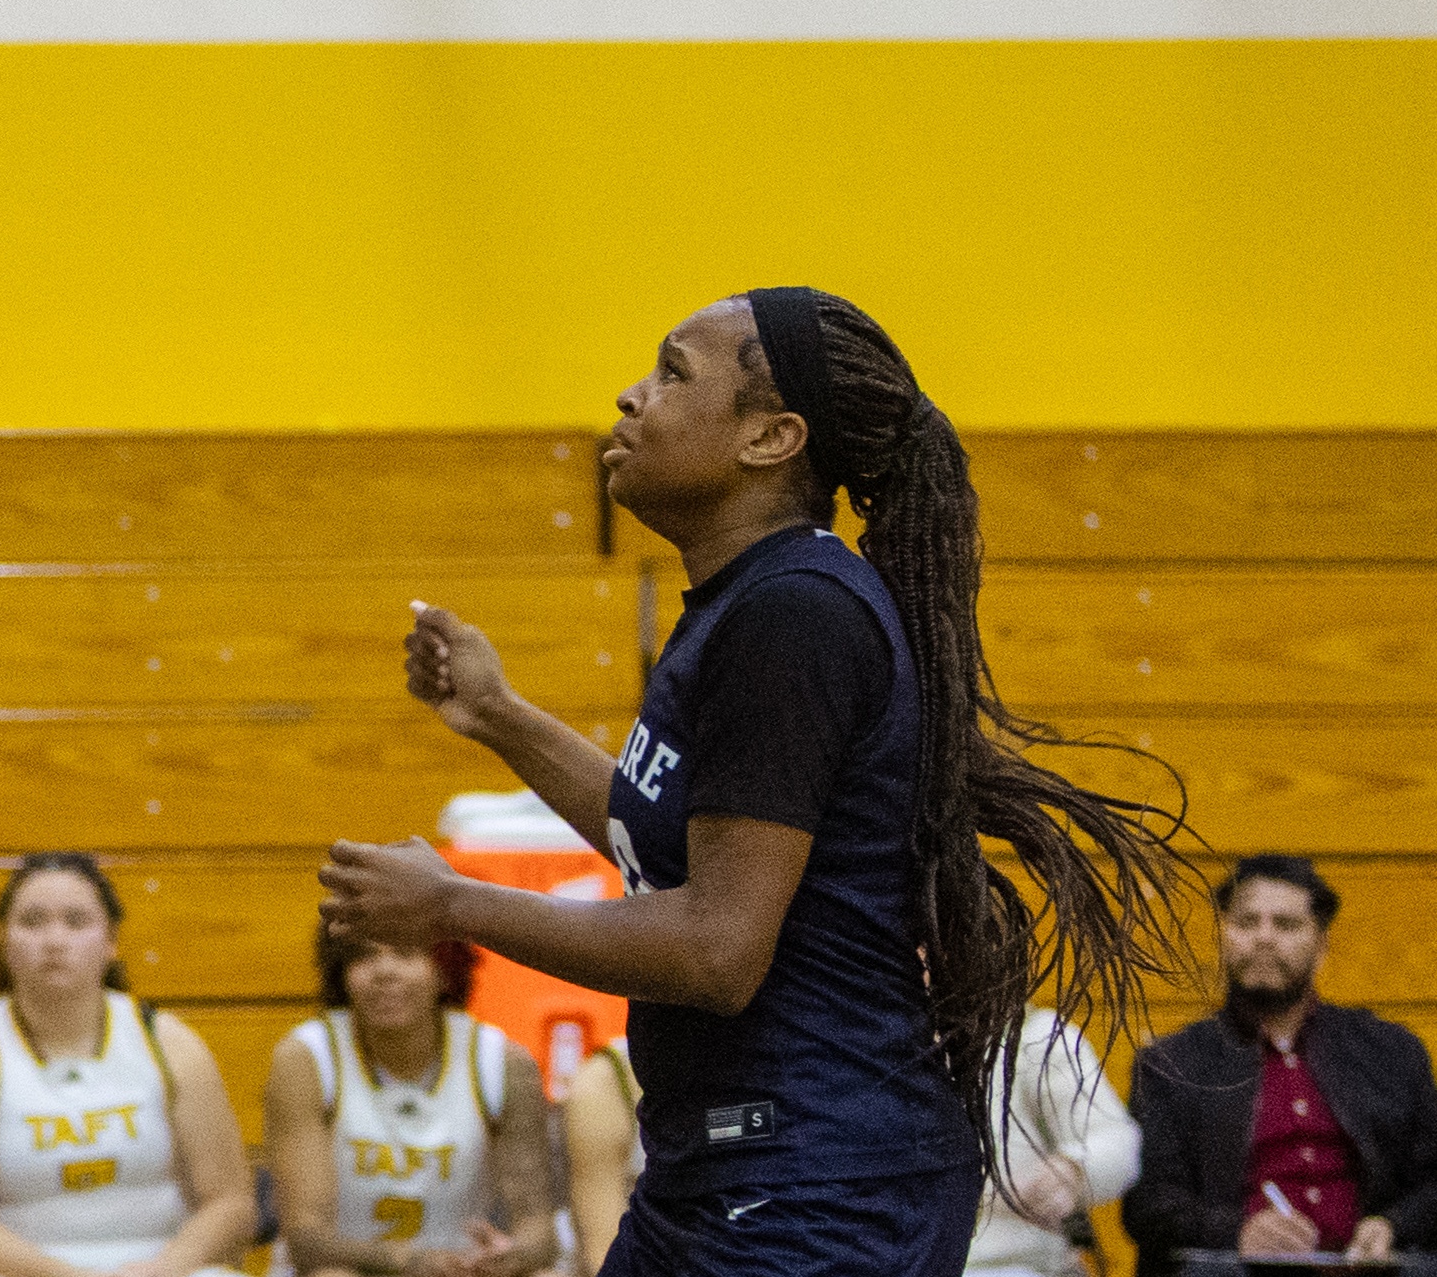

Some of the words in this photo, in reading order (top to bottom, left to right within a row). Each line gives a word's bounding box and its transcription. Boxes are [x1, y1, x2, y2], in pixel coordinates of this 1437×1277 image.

[24, 1104, 138, 1151] TAFT
[751, 1112, 763, 1128] S
[348, 1138, 456, 1182] TAFT
